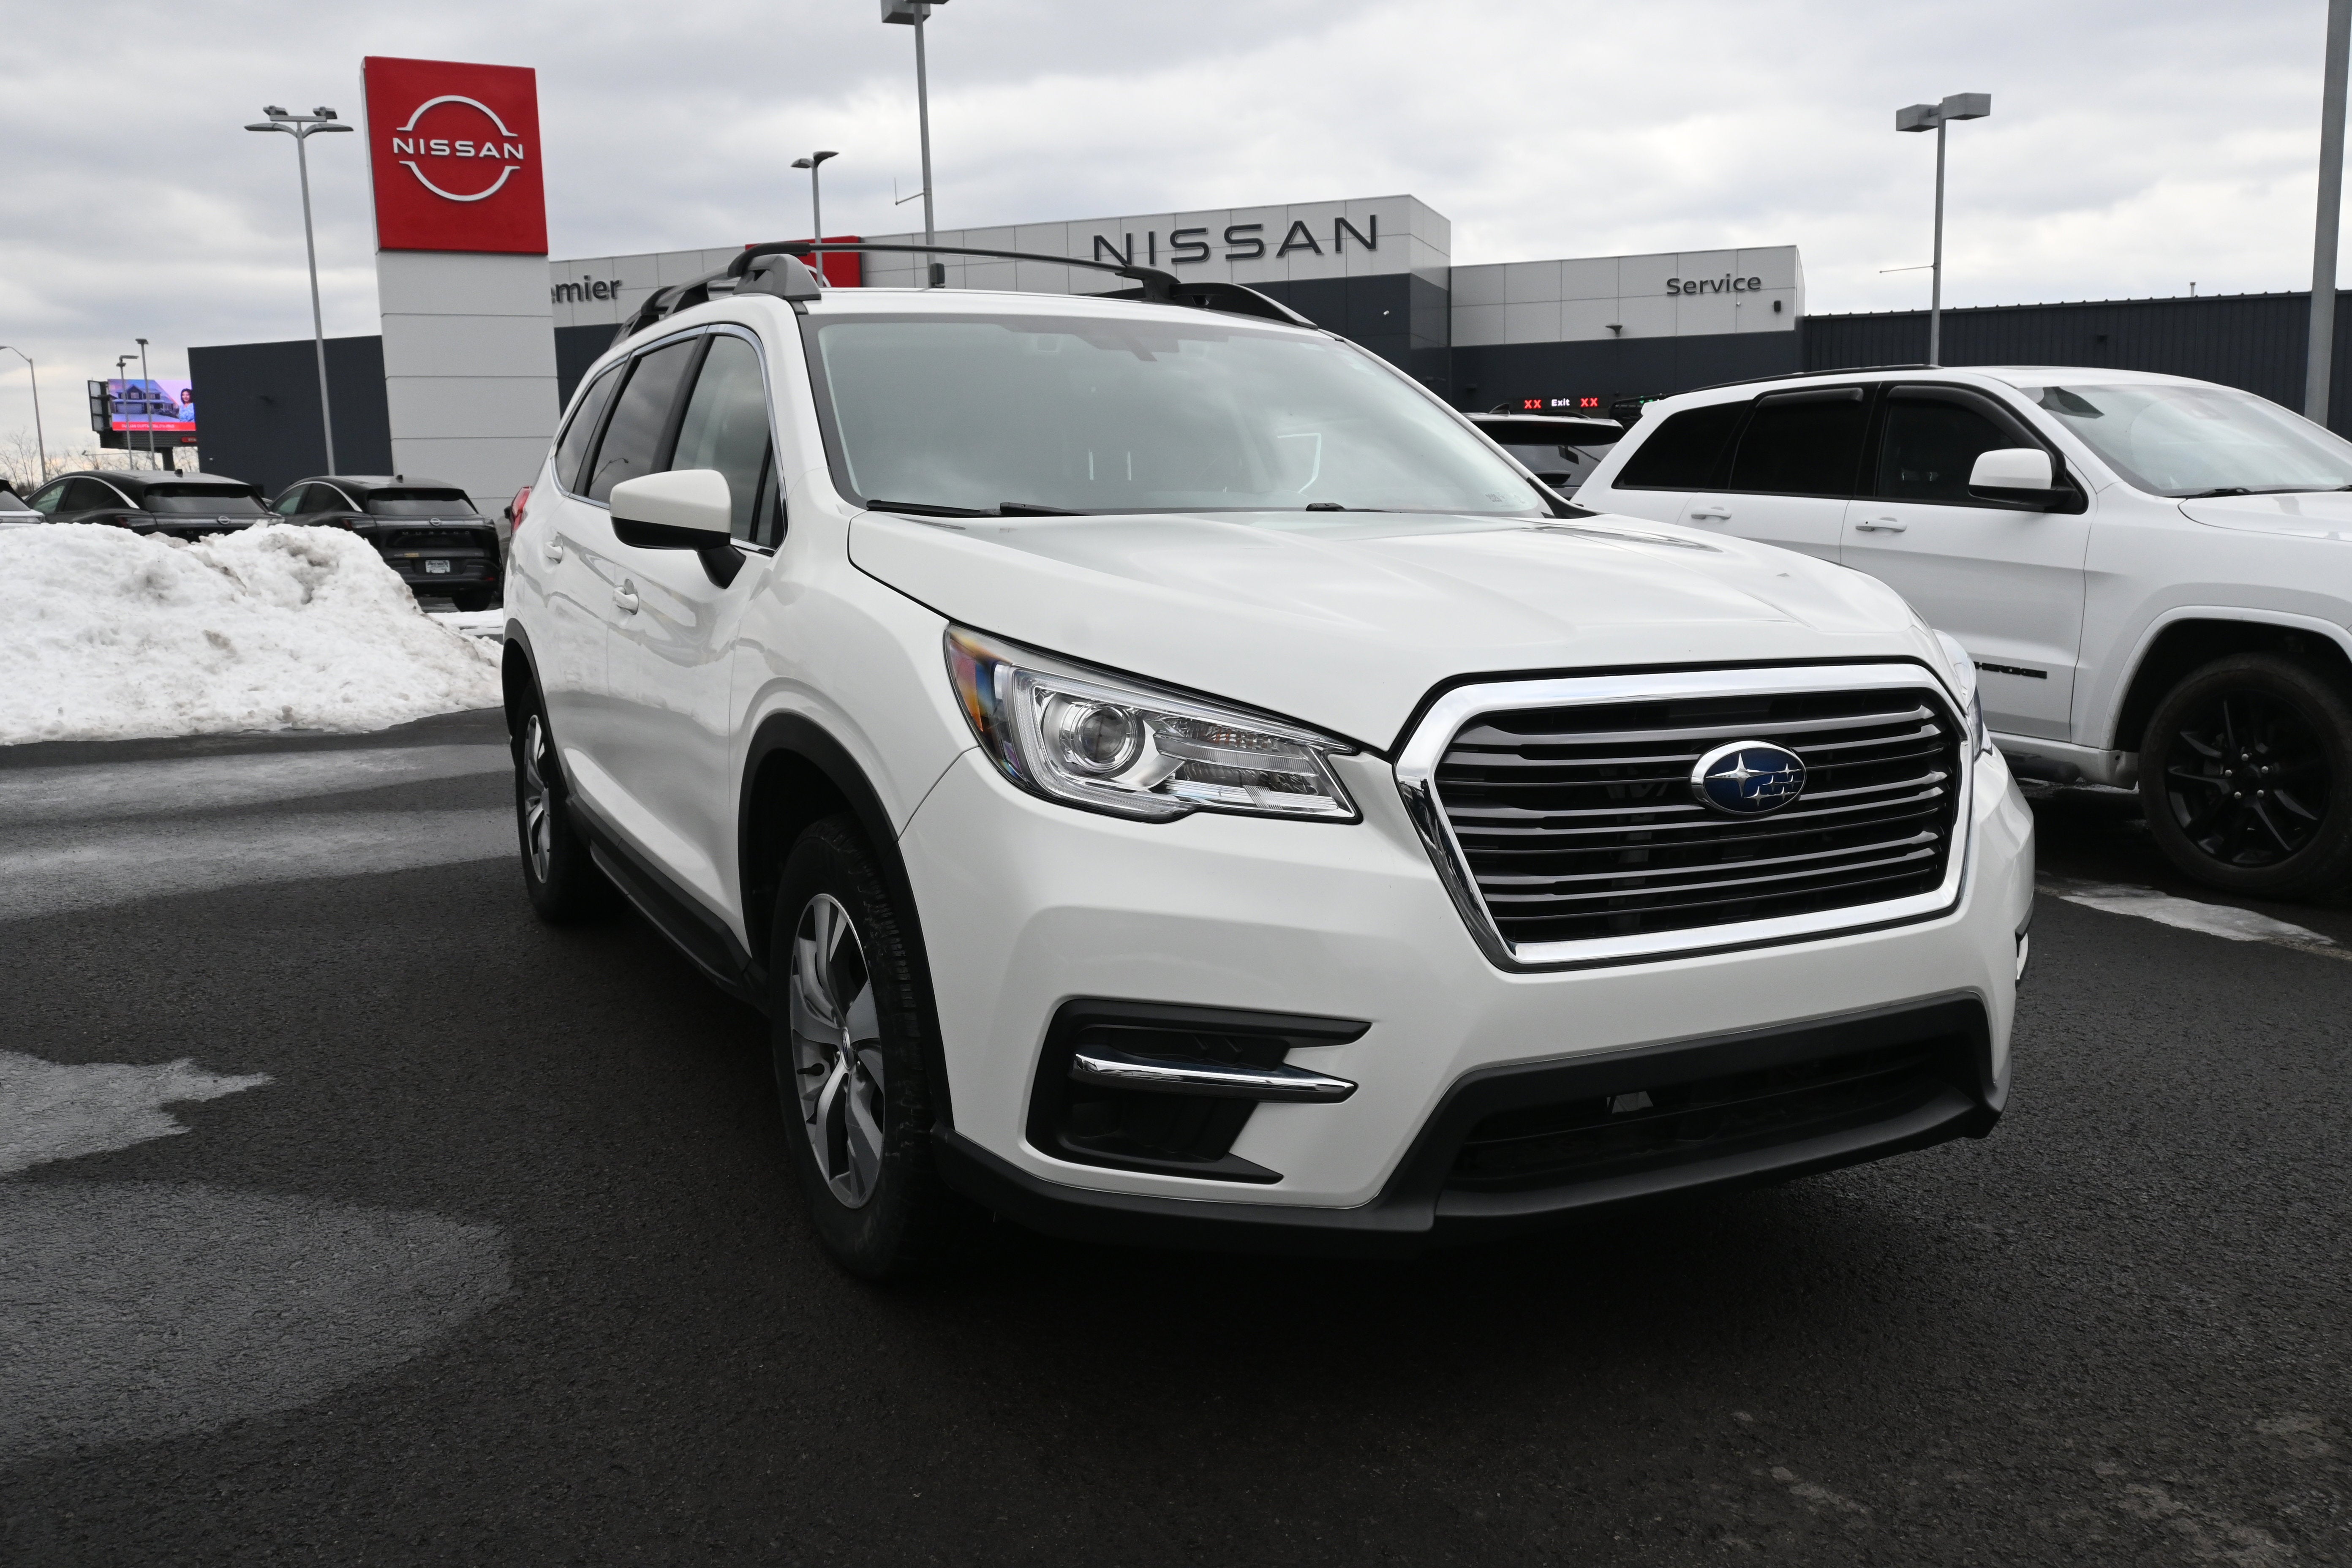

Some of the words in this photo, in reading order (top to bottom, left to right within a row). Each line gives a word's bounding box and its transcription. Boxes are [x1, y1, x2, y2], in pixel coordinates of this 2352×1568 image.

[392, 137, 524, 160] NISSAN
[1093, 214, 1377, 266] NISSAN
[551, 275, 622, 303] mier
[1666, 273, 1761, 295] Service
[1524, 399, 1541, 409] XX
[1551, 398, 1570, 406] Exit
[1581, 397, 1598, 407] XX
